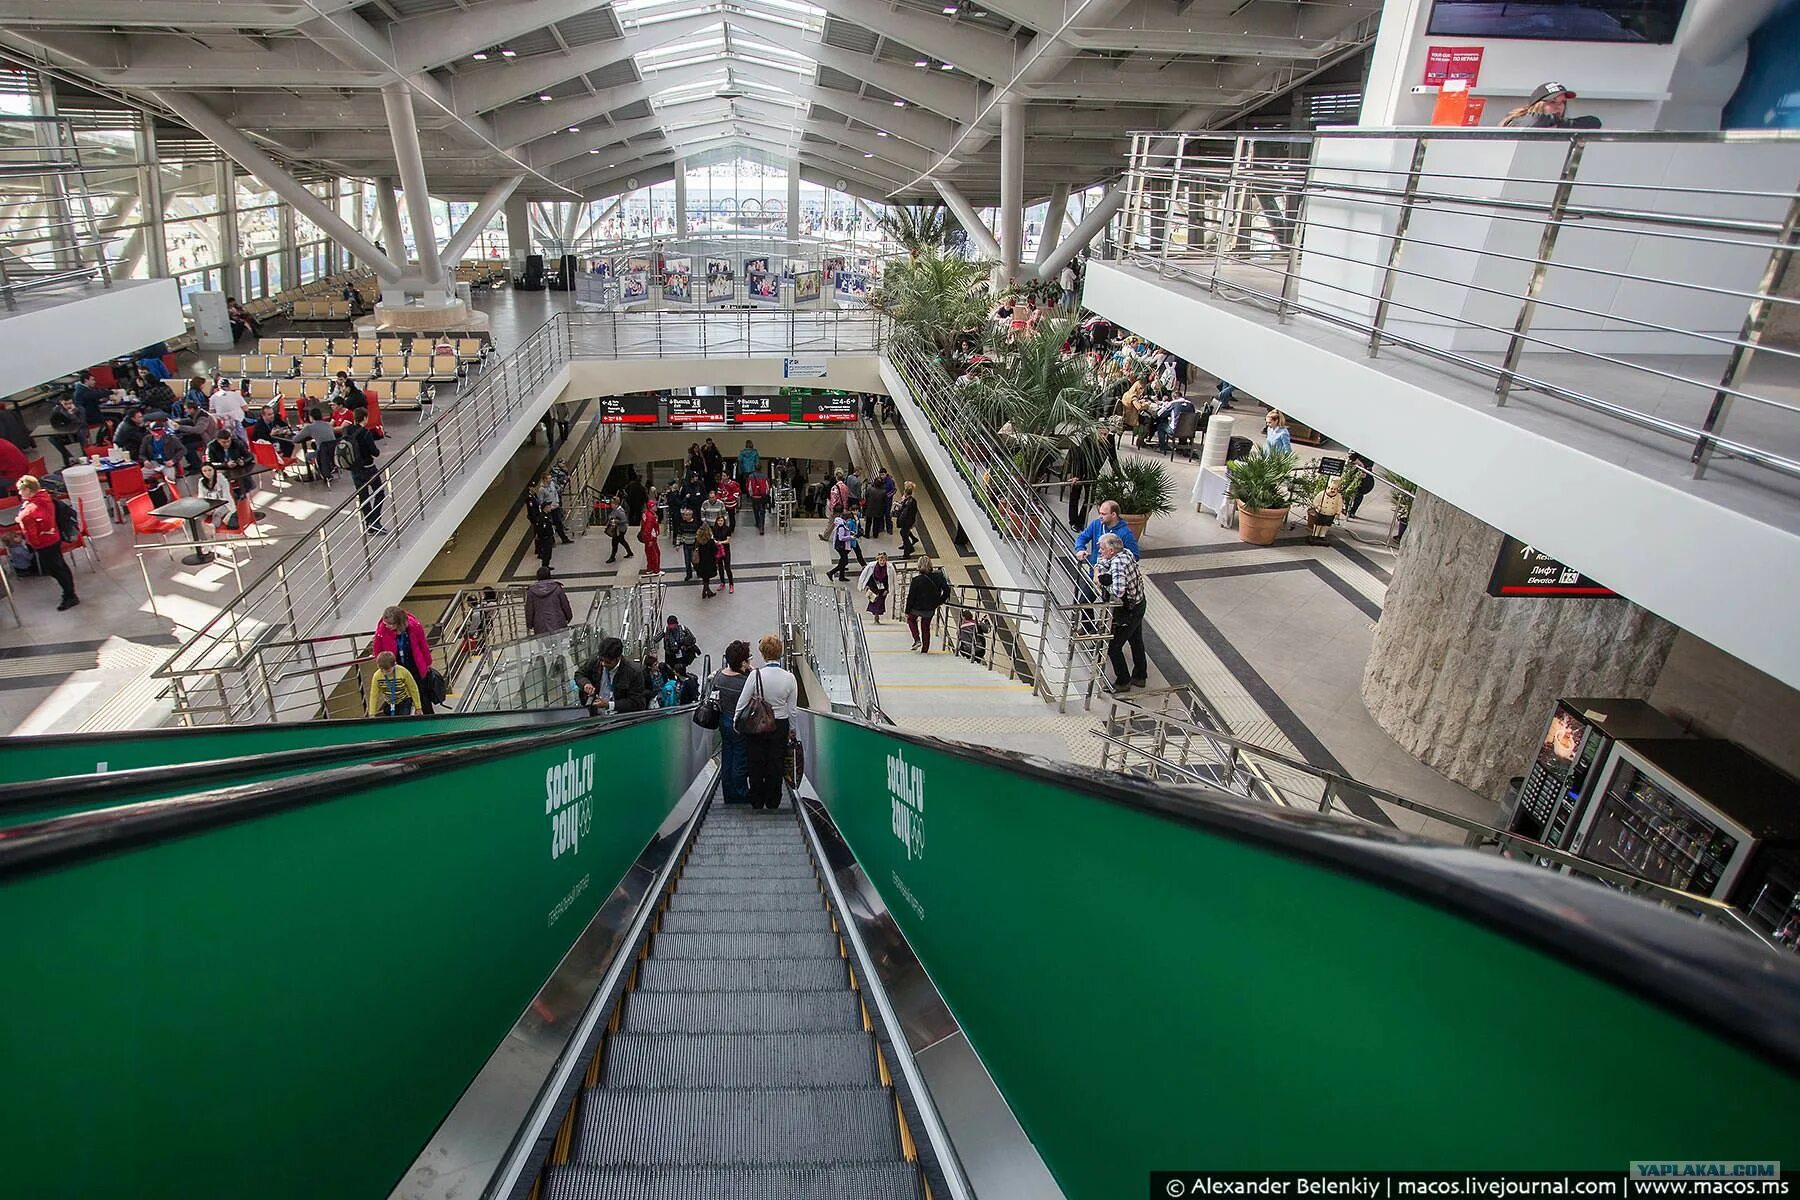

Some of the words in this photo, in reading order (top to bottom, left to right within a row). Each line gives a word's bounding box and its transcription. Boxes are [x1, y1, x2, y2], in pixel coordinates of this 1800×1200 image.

[1531, 566, 1557, 576] Лифт
[545, 748, 594, 815] sochi.ru
[887, 748, 924, 813] sochi.ru
[552, 801, 578, 860] 2014
[891, 796, 911, 861] 2014
